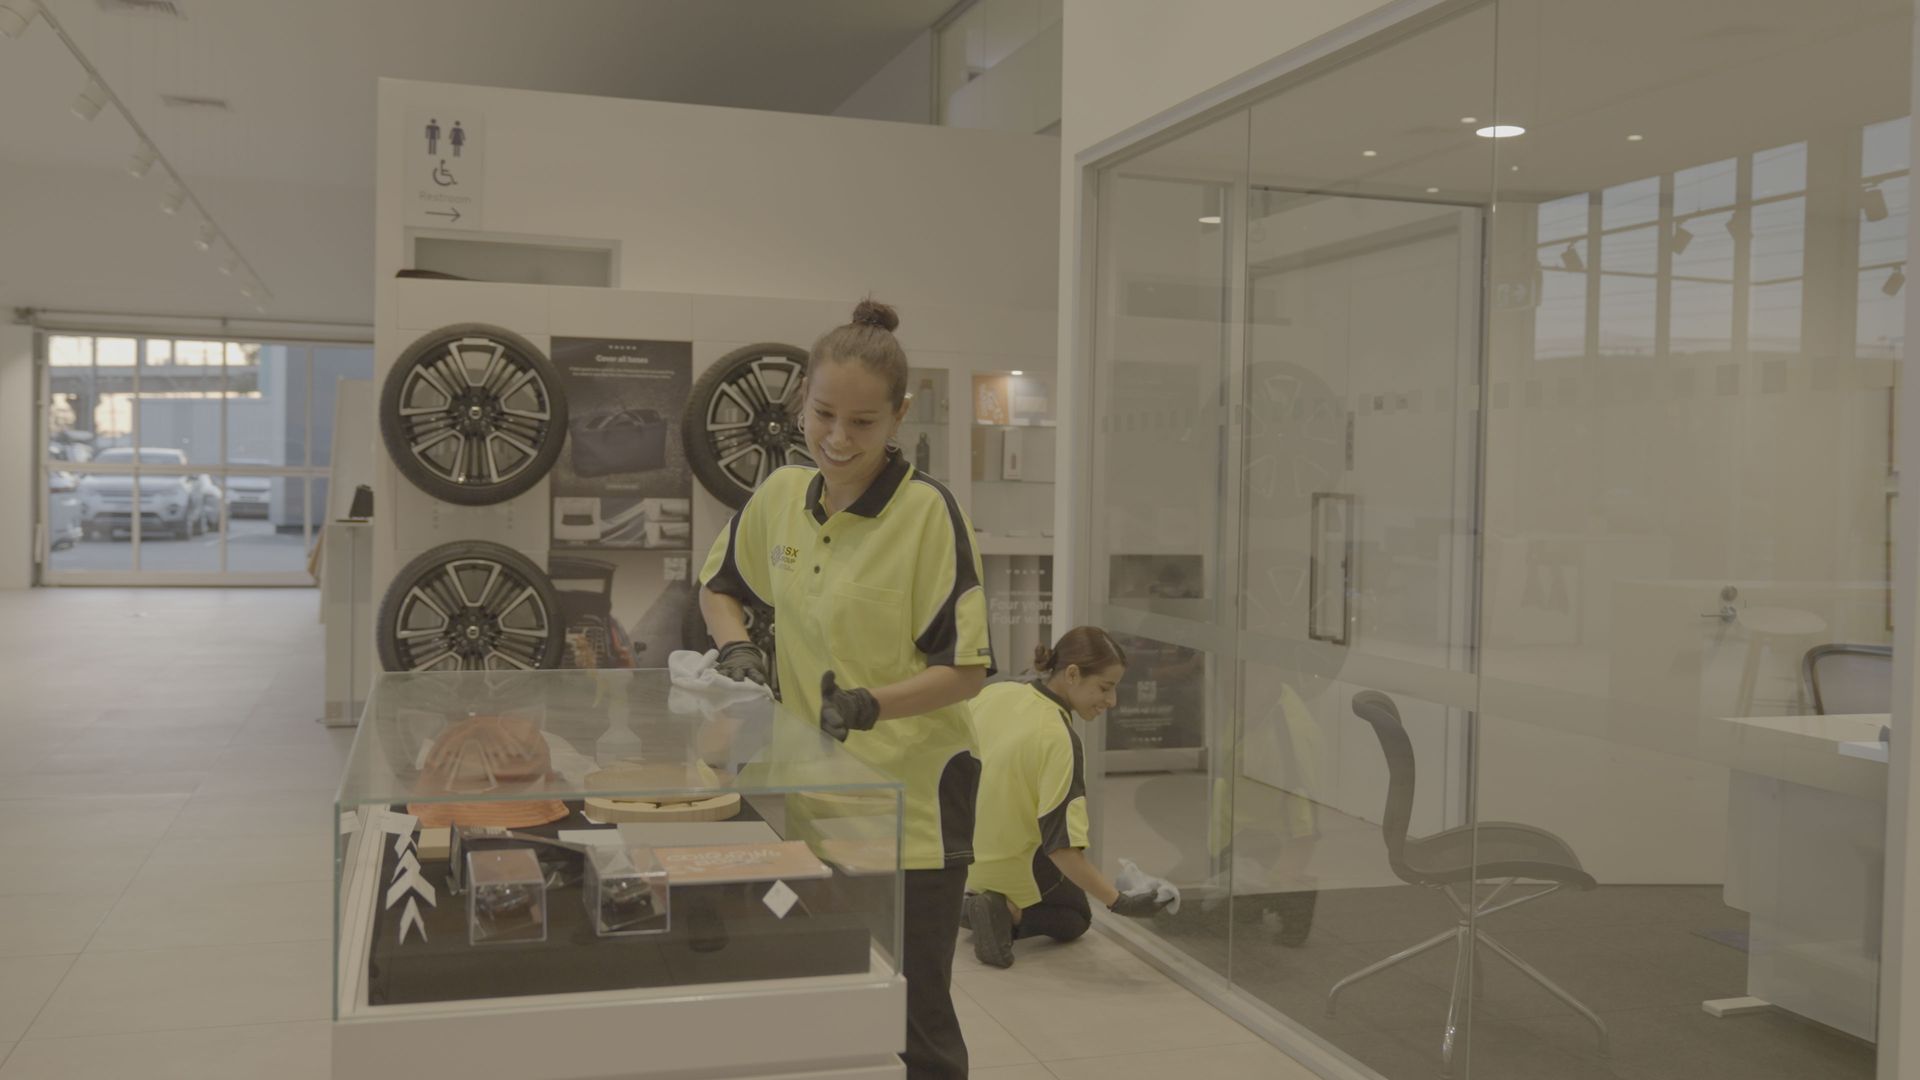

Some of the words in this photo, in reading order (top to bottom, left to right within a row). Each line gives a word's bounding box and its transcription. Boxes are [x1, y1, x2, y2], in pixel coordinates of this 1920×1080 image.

[418, 190, 472, 205] Restroom
[990, 598, 1019, 611] Four
[991, 612, 1021, 624] Four
